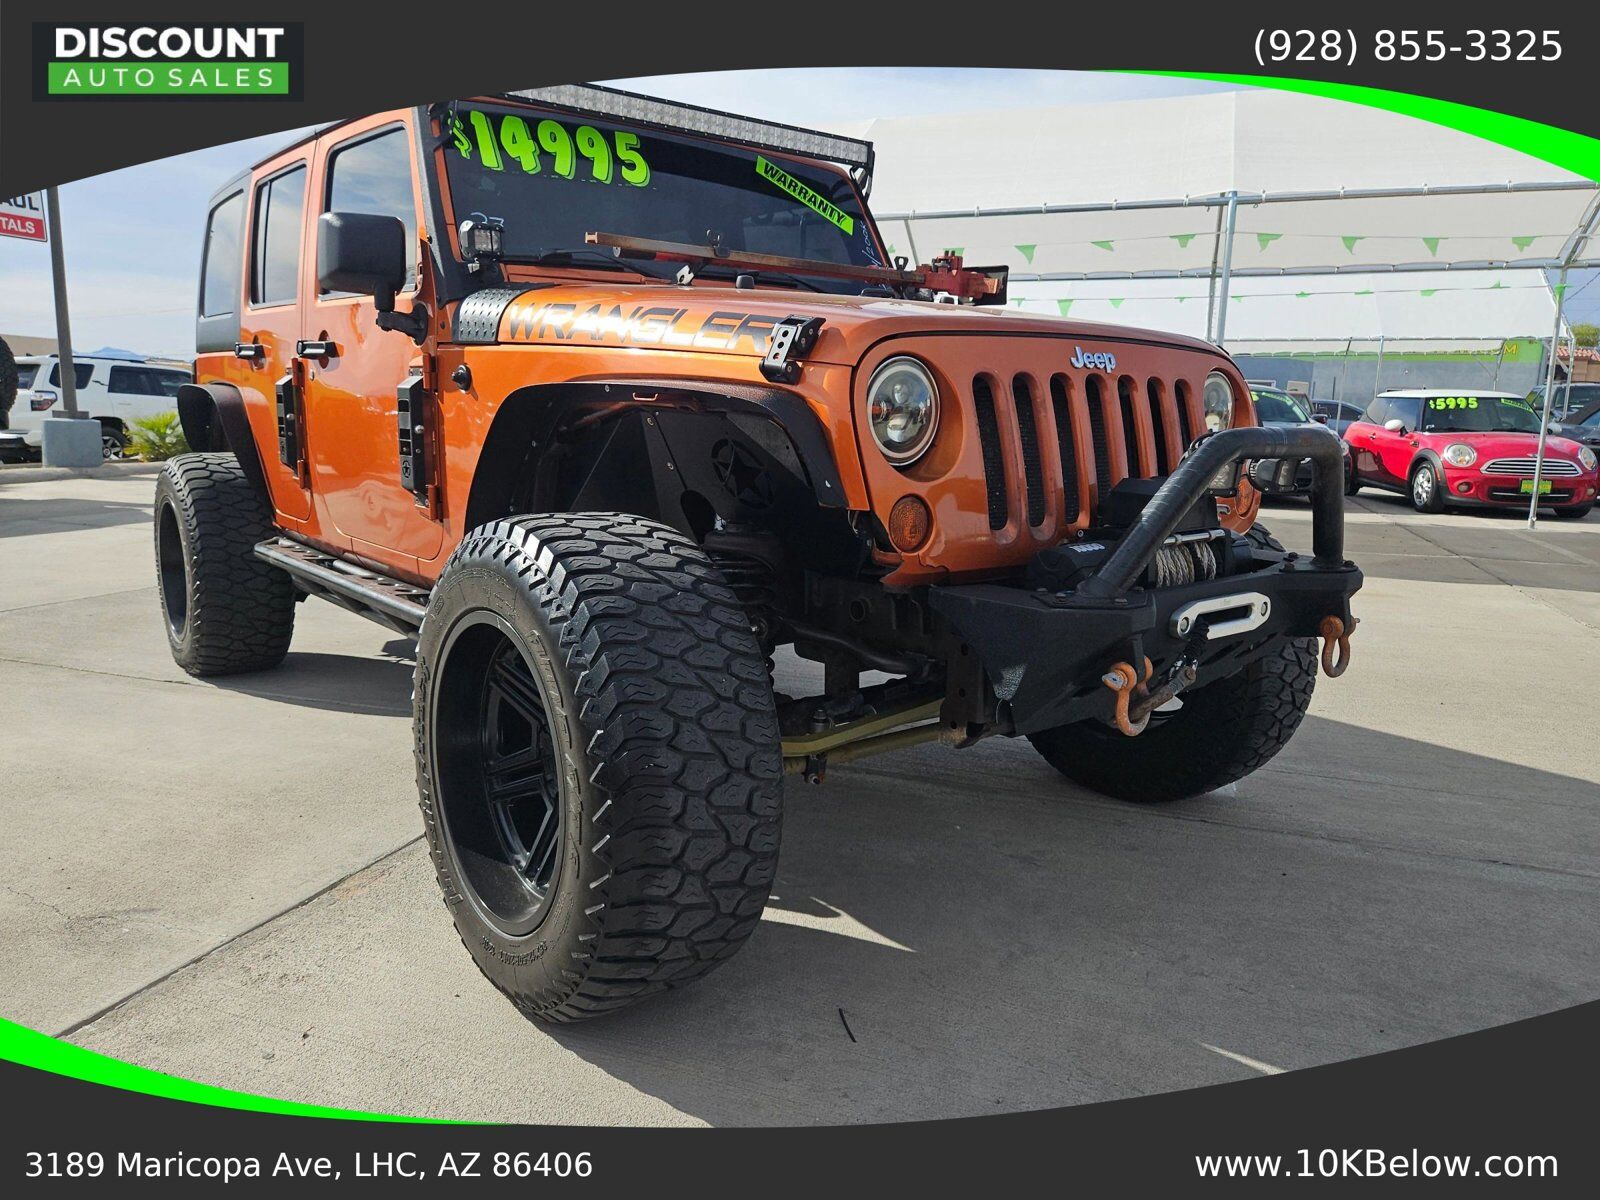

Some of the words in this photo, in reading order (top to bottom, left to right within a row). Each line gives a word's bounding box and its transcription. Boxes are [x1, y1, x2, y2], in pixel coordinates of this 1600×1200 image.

[448, 110, 651, 188] $14995
[763, 161, 847, 227] WARRANTY
[506, 302, 779, 353] WRANGLER
[1070, 346, 1116, 373] Jeep
[1429, 397, 1478, 411] $5995
